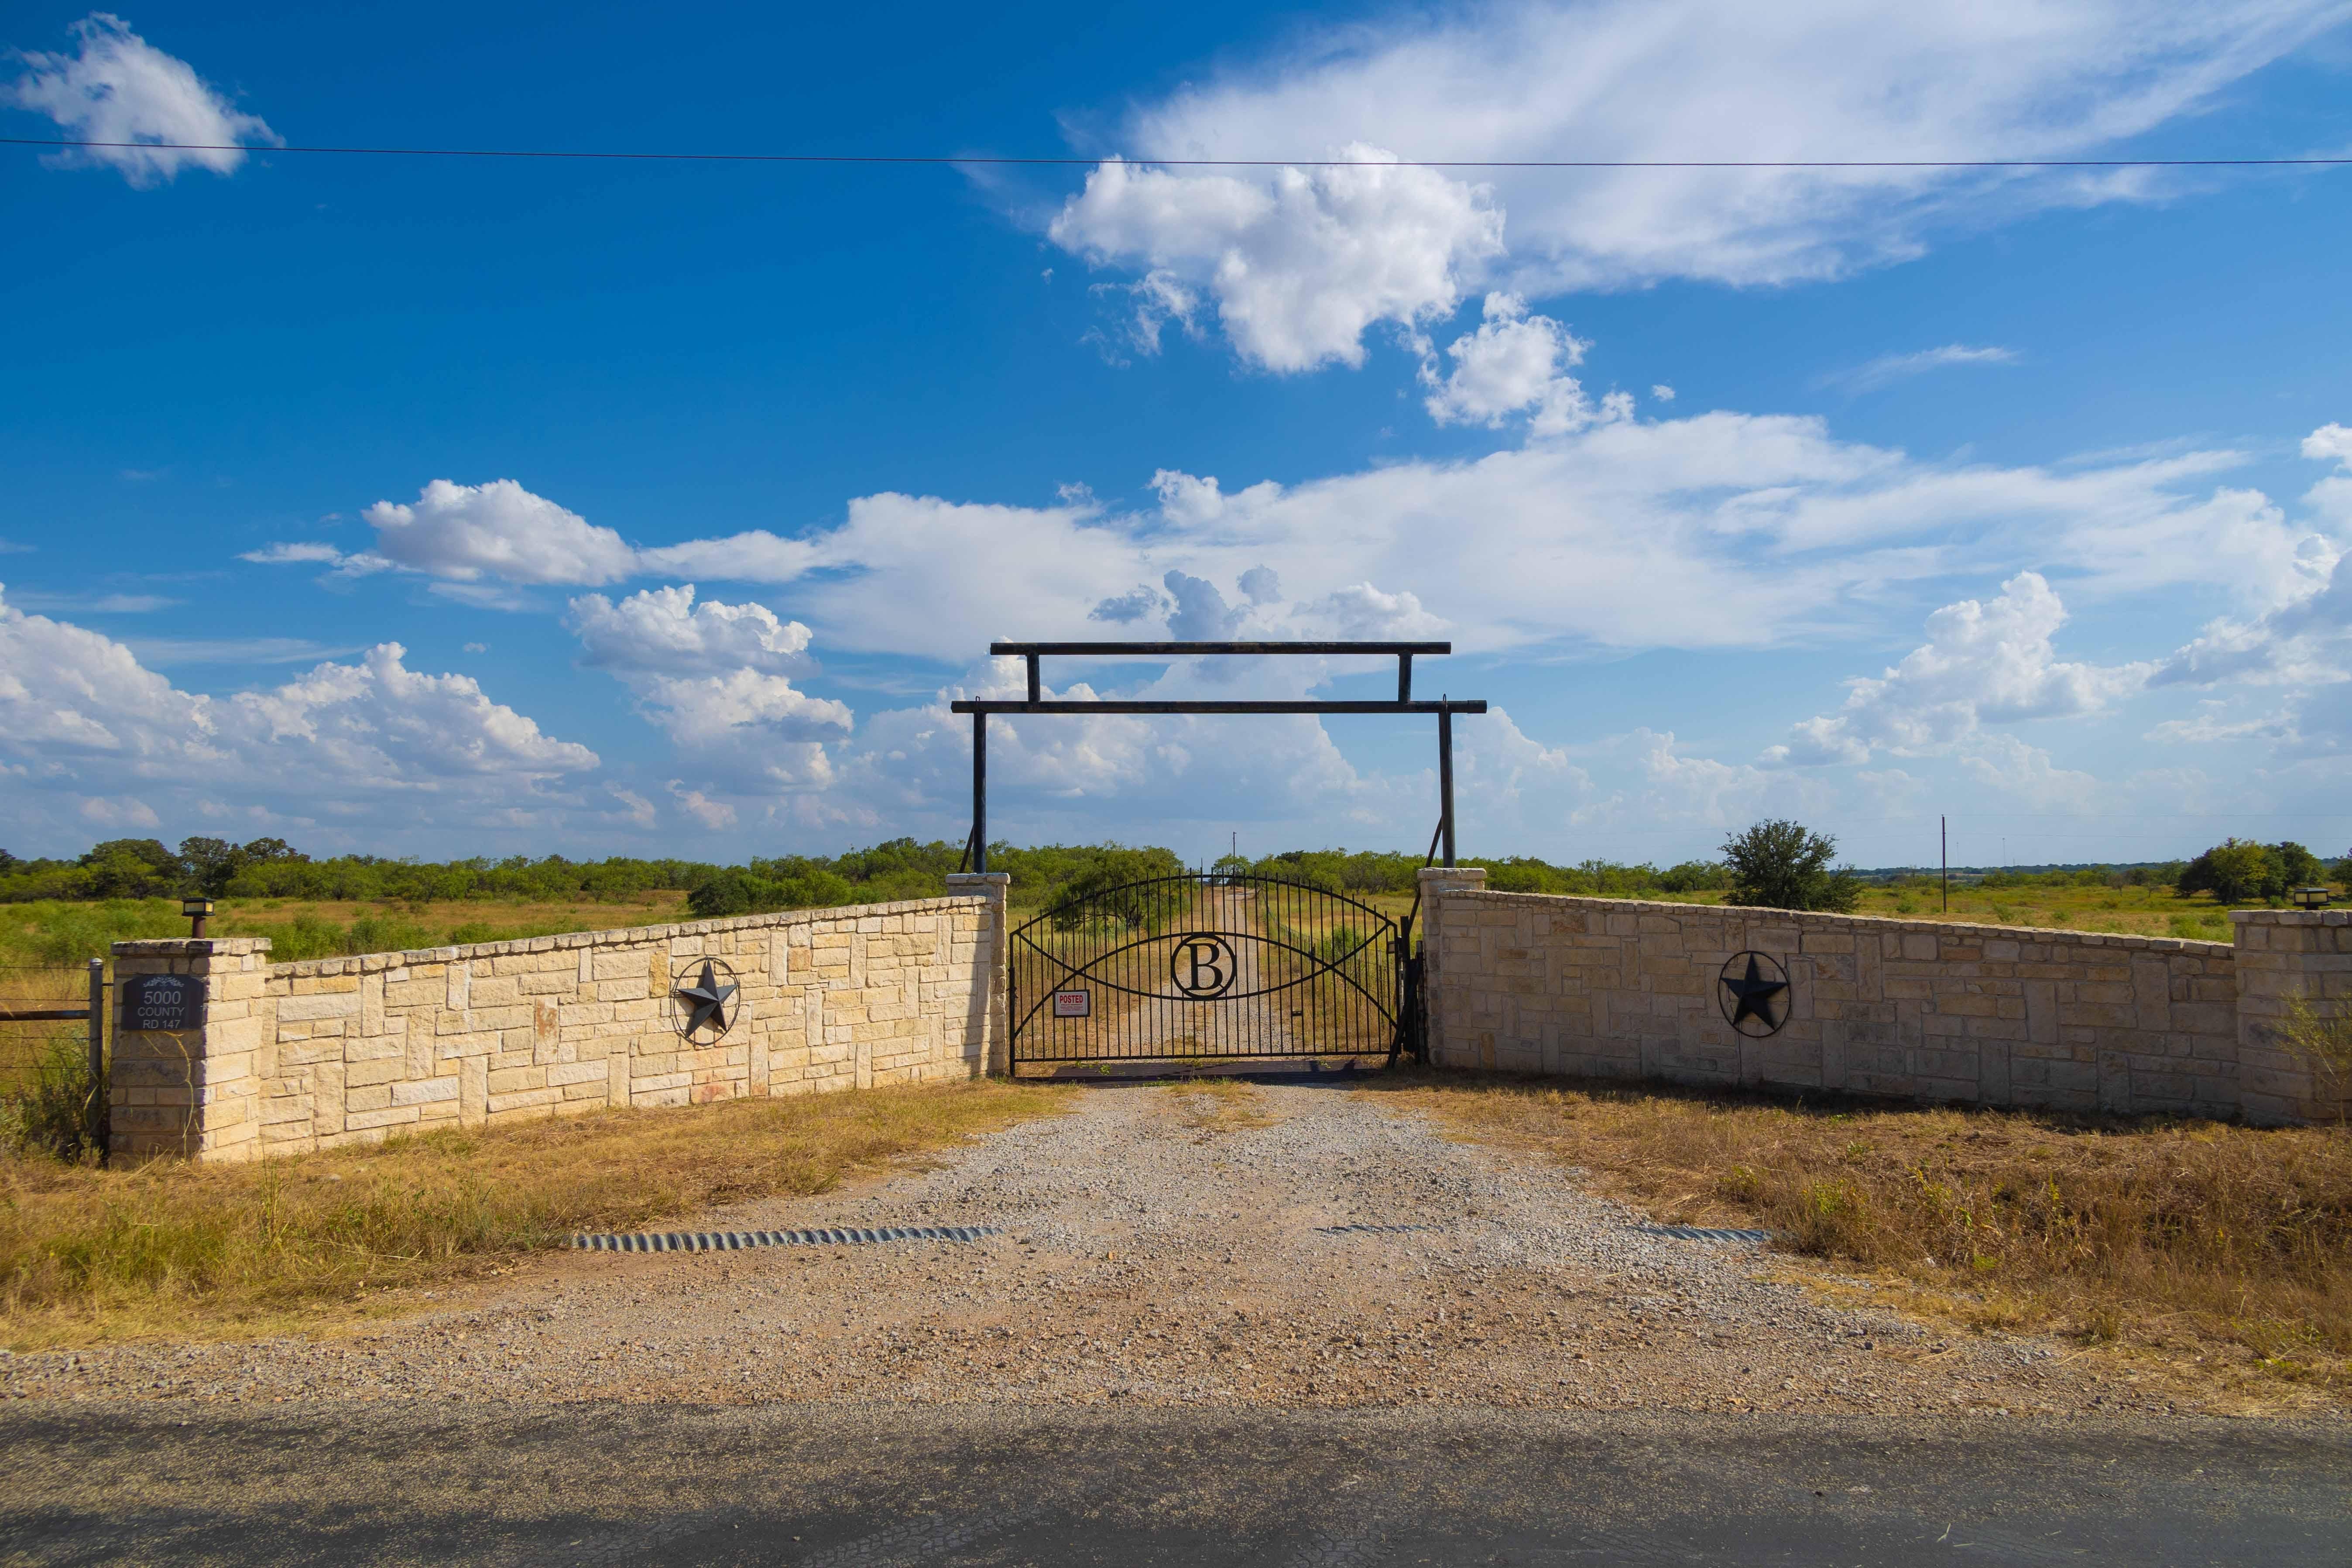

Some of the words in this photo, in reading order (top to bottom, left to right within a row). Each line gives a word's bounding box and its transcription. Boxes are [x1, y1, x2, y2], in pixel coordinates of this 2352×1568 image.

[1183, 943, 1223, 991] B
[143, 991, 181, 1004] 5000
[1059, 995, 1083, 1003] POSTED
[137, 1007, 185, 1016] COUNTY
[143, 1019, 159, 1029] RD
[163, 1019, 181, 1029] 147
